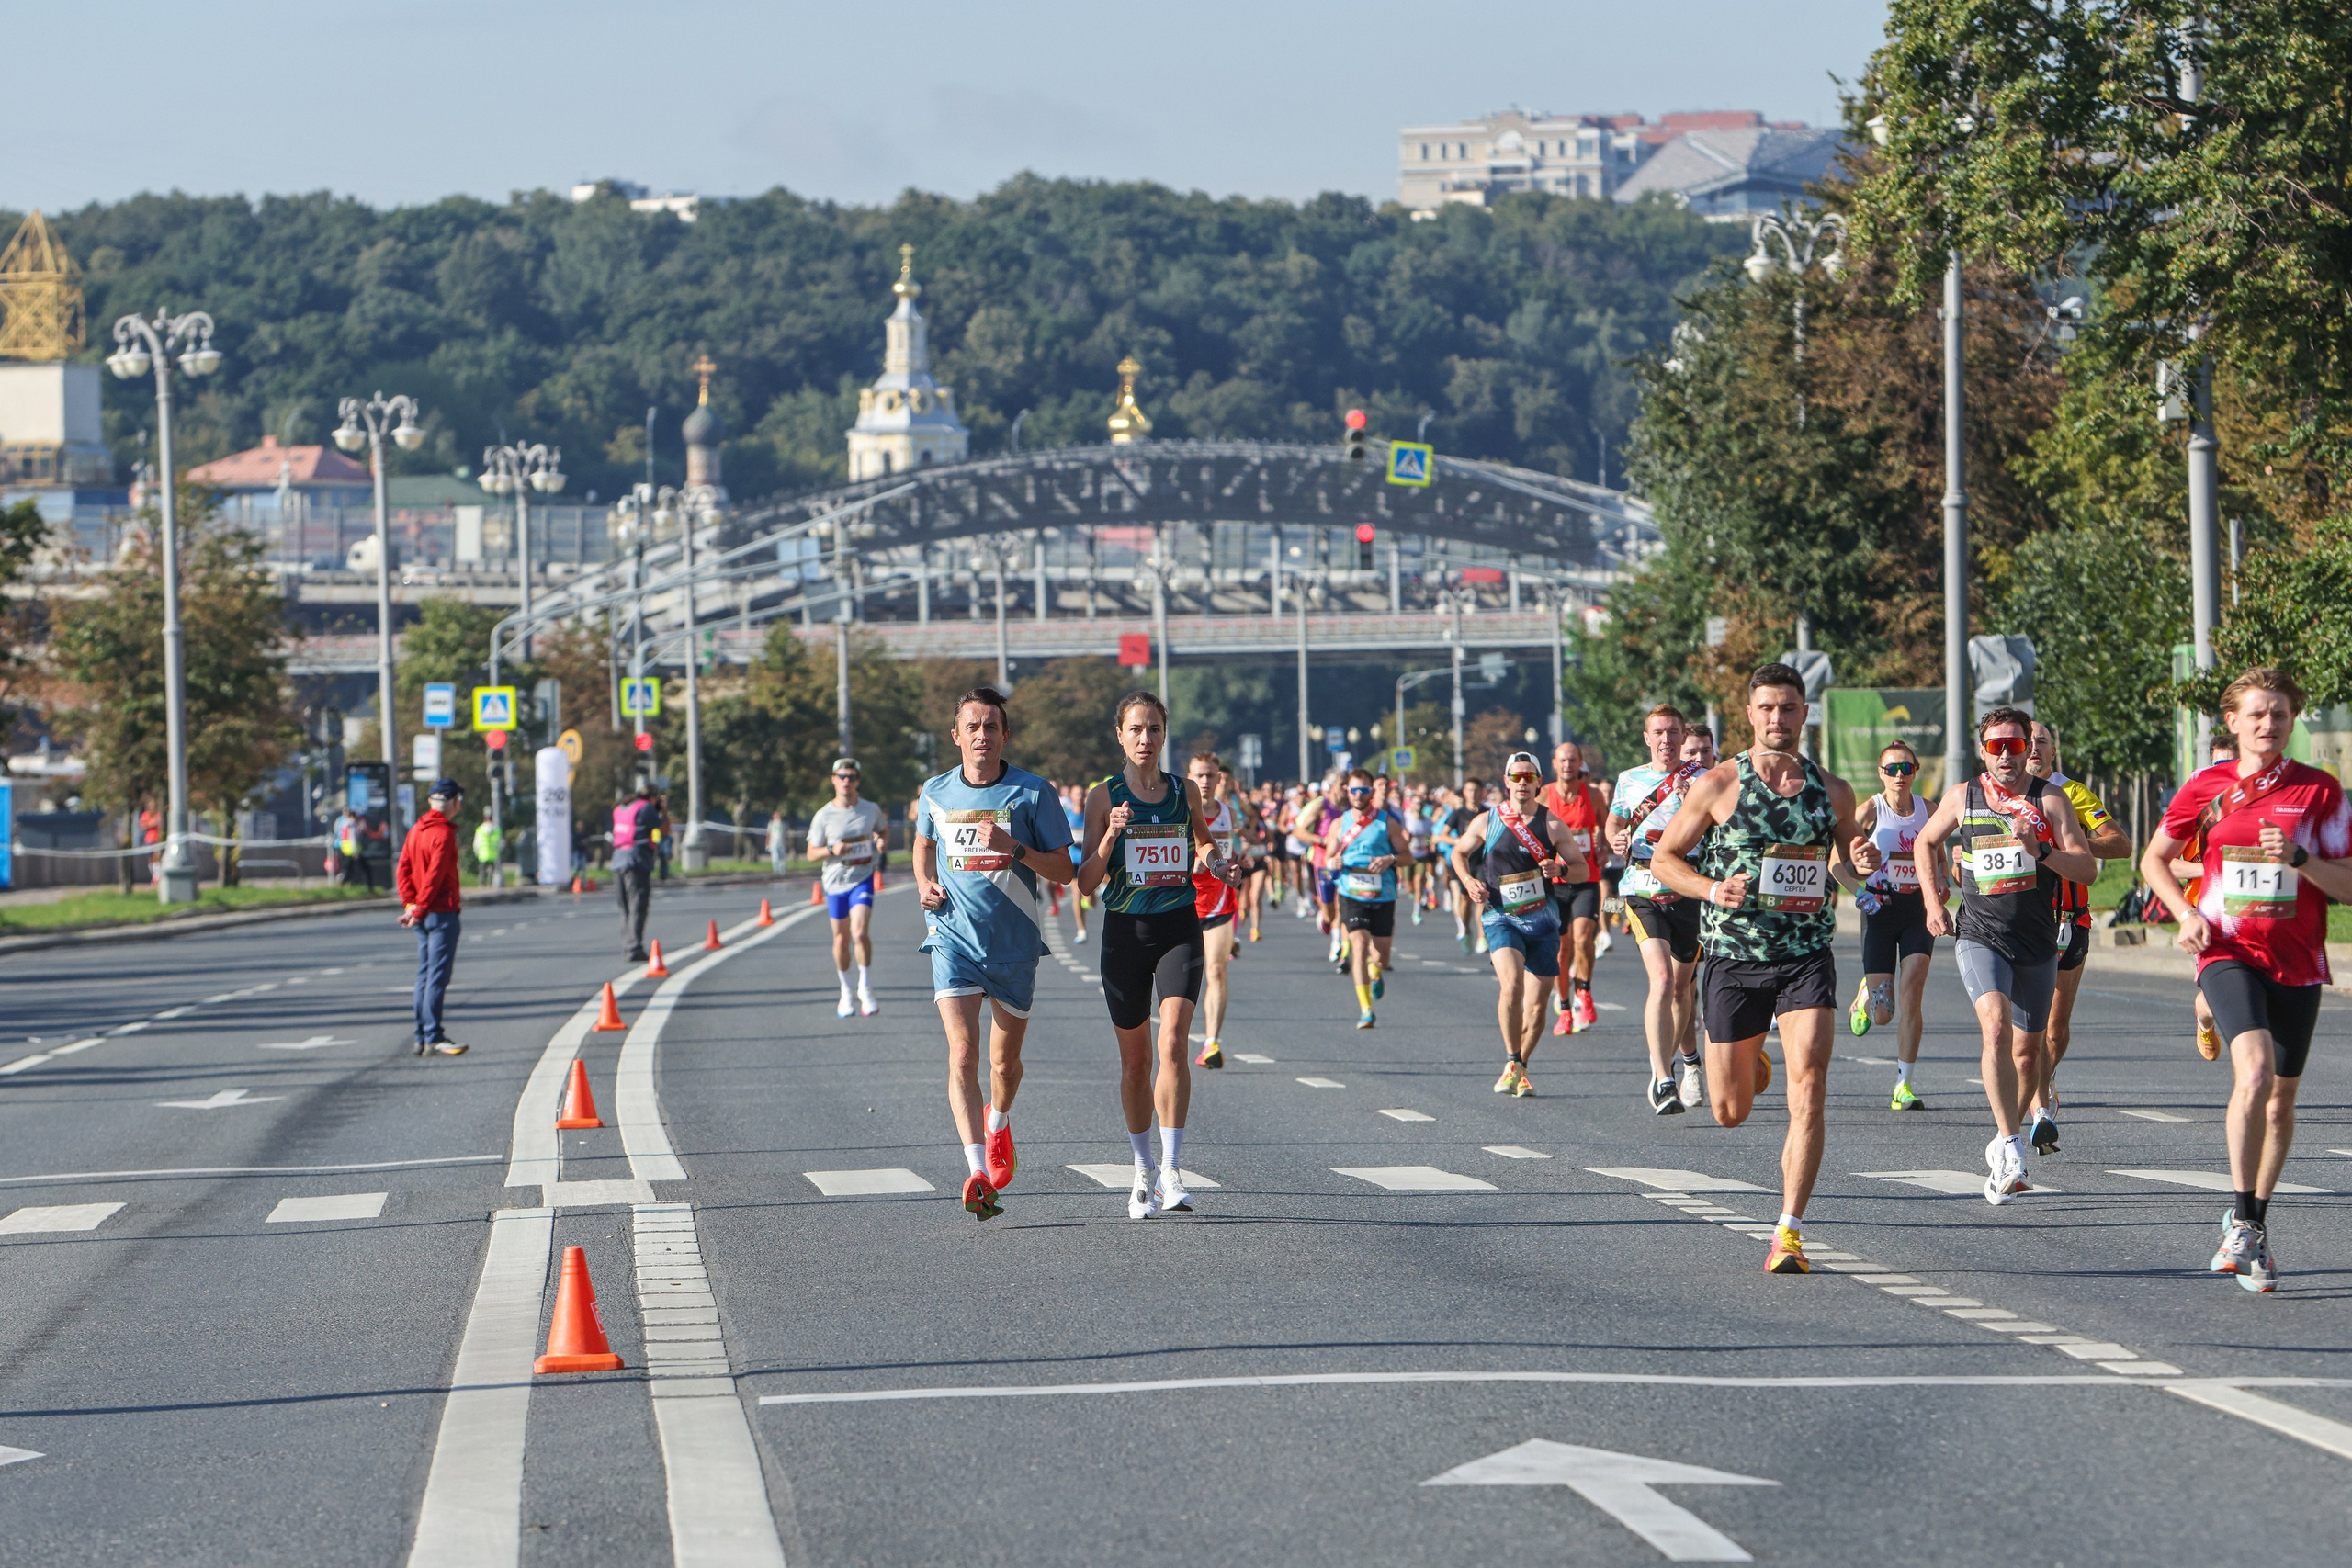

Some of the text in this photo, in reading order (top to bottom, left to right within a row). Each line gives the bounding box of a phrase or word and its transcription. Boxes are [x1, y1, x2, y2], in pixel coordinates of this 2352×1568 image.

[1660, 783, 1671, 794] 74
[1998, 791, 2047, 832] ЭСТАФТА
[955, 828, 980, 846] 47
[1217, 841, 1229, 851] 59
[1513, 821, 1545, 859] ЭСТАФЕТА
[1136, 845, 1181, 864] 7510
[1983, 851, 2022, 871] 38-1
[1772, 864, 1818, 885] 6302
[1894, 865, 1917, 878] 799
[2236, 869, 2283, 890] 11-1
[1509, 883, 1537, 899] 57-1
